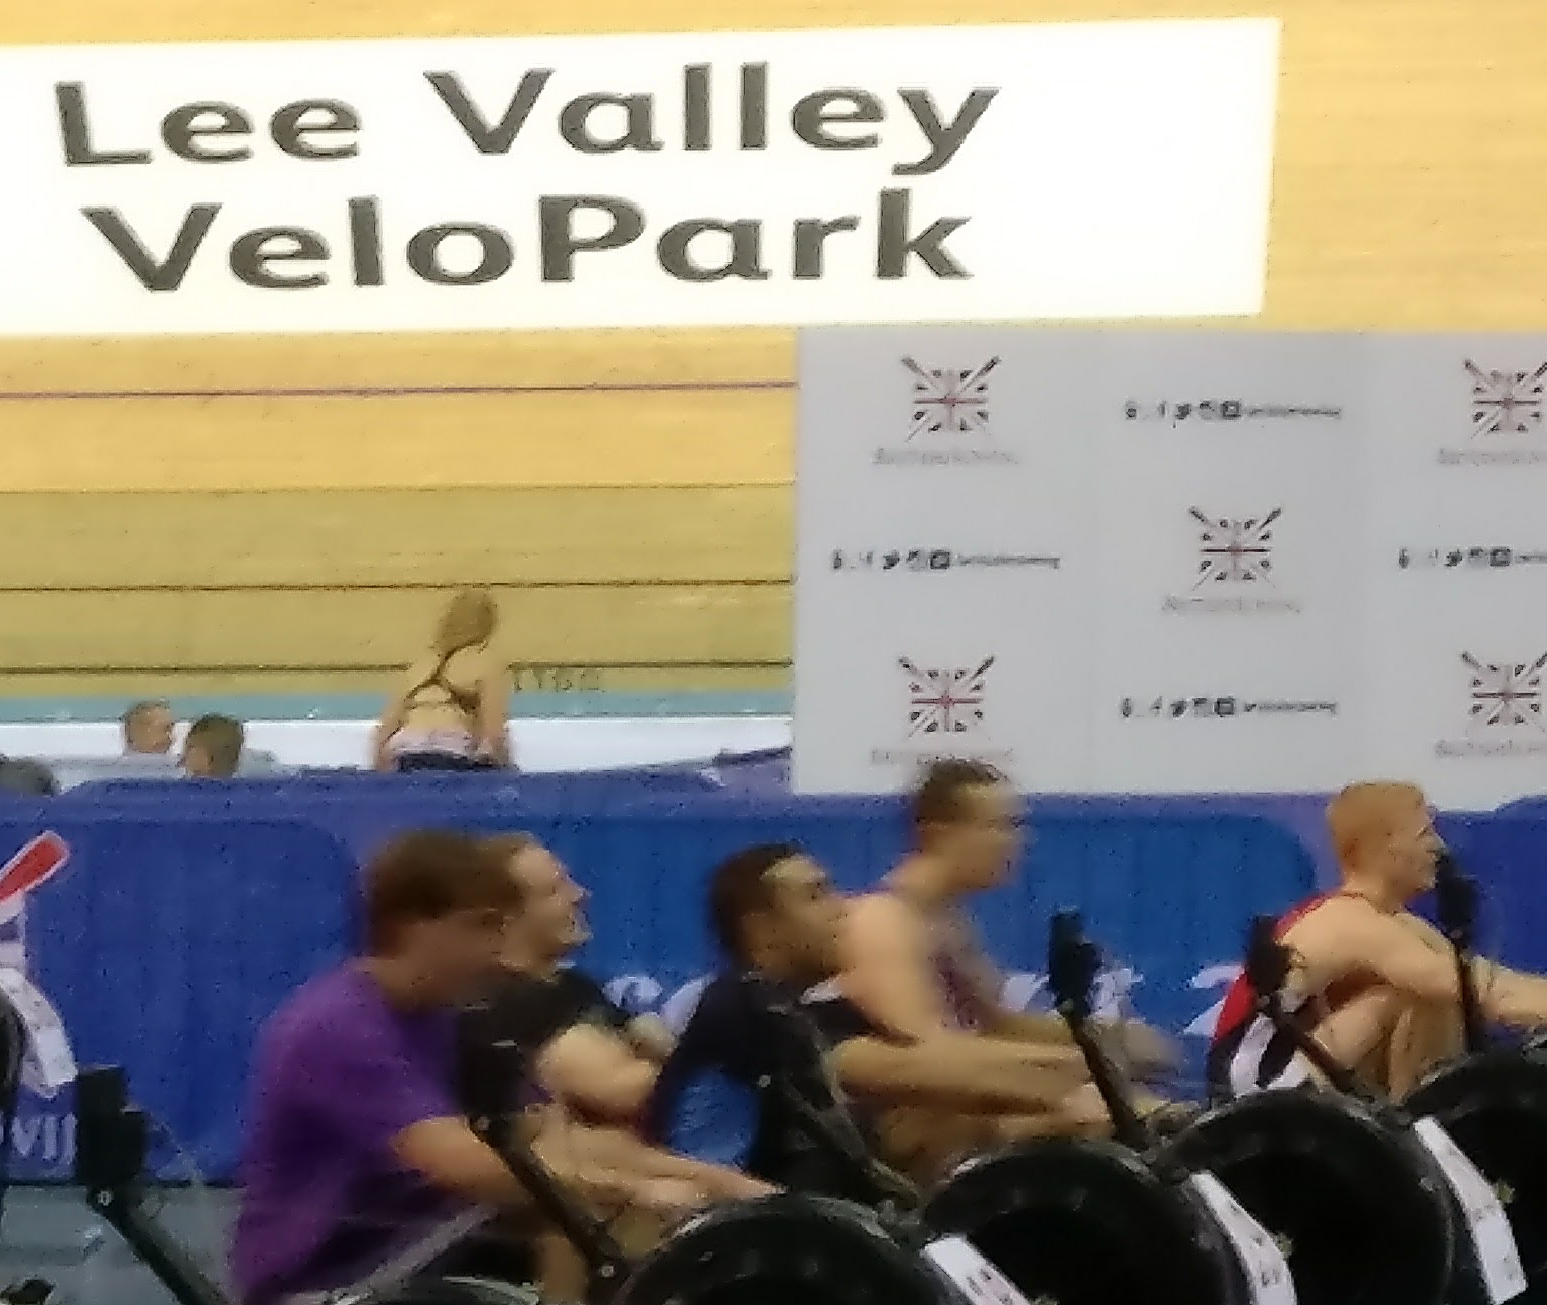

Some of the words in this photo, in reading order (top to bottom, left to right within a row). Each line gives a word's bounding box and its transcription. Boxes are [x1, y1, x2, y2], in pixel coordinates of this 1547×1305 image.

[54, 79, 362, 166] Lee
[422, 61, 1001, 175] Valley
[79, 187, 974, 293] VeloPark
